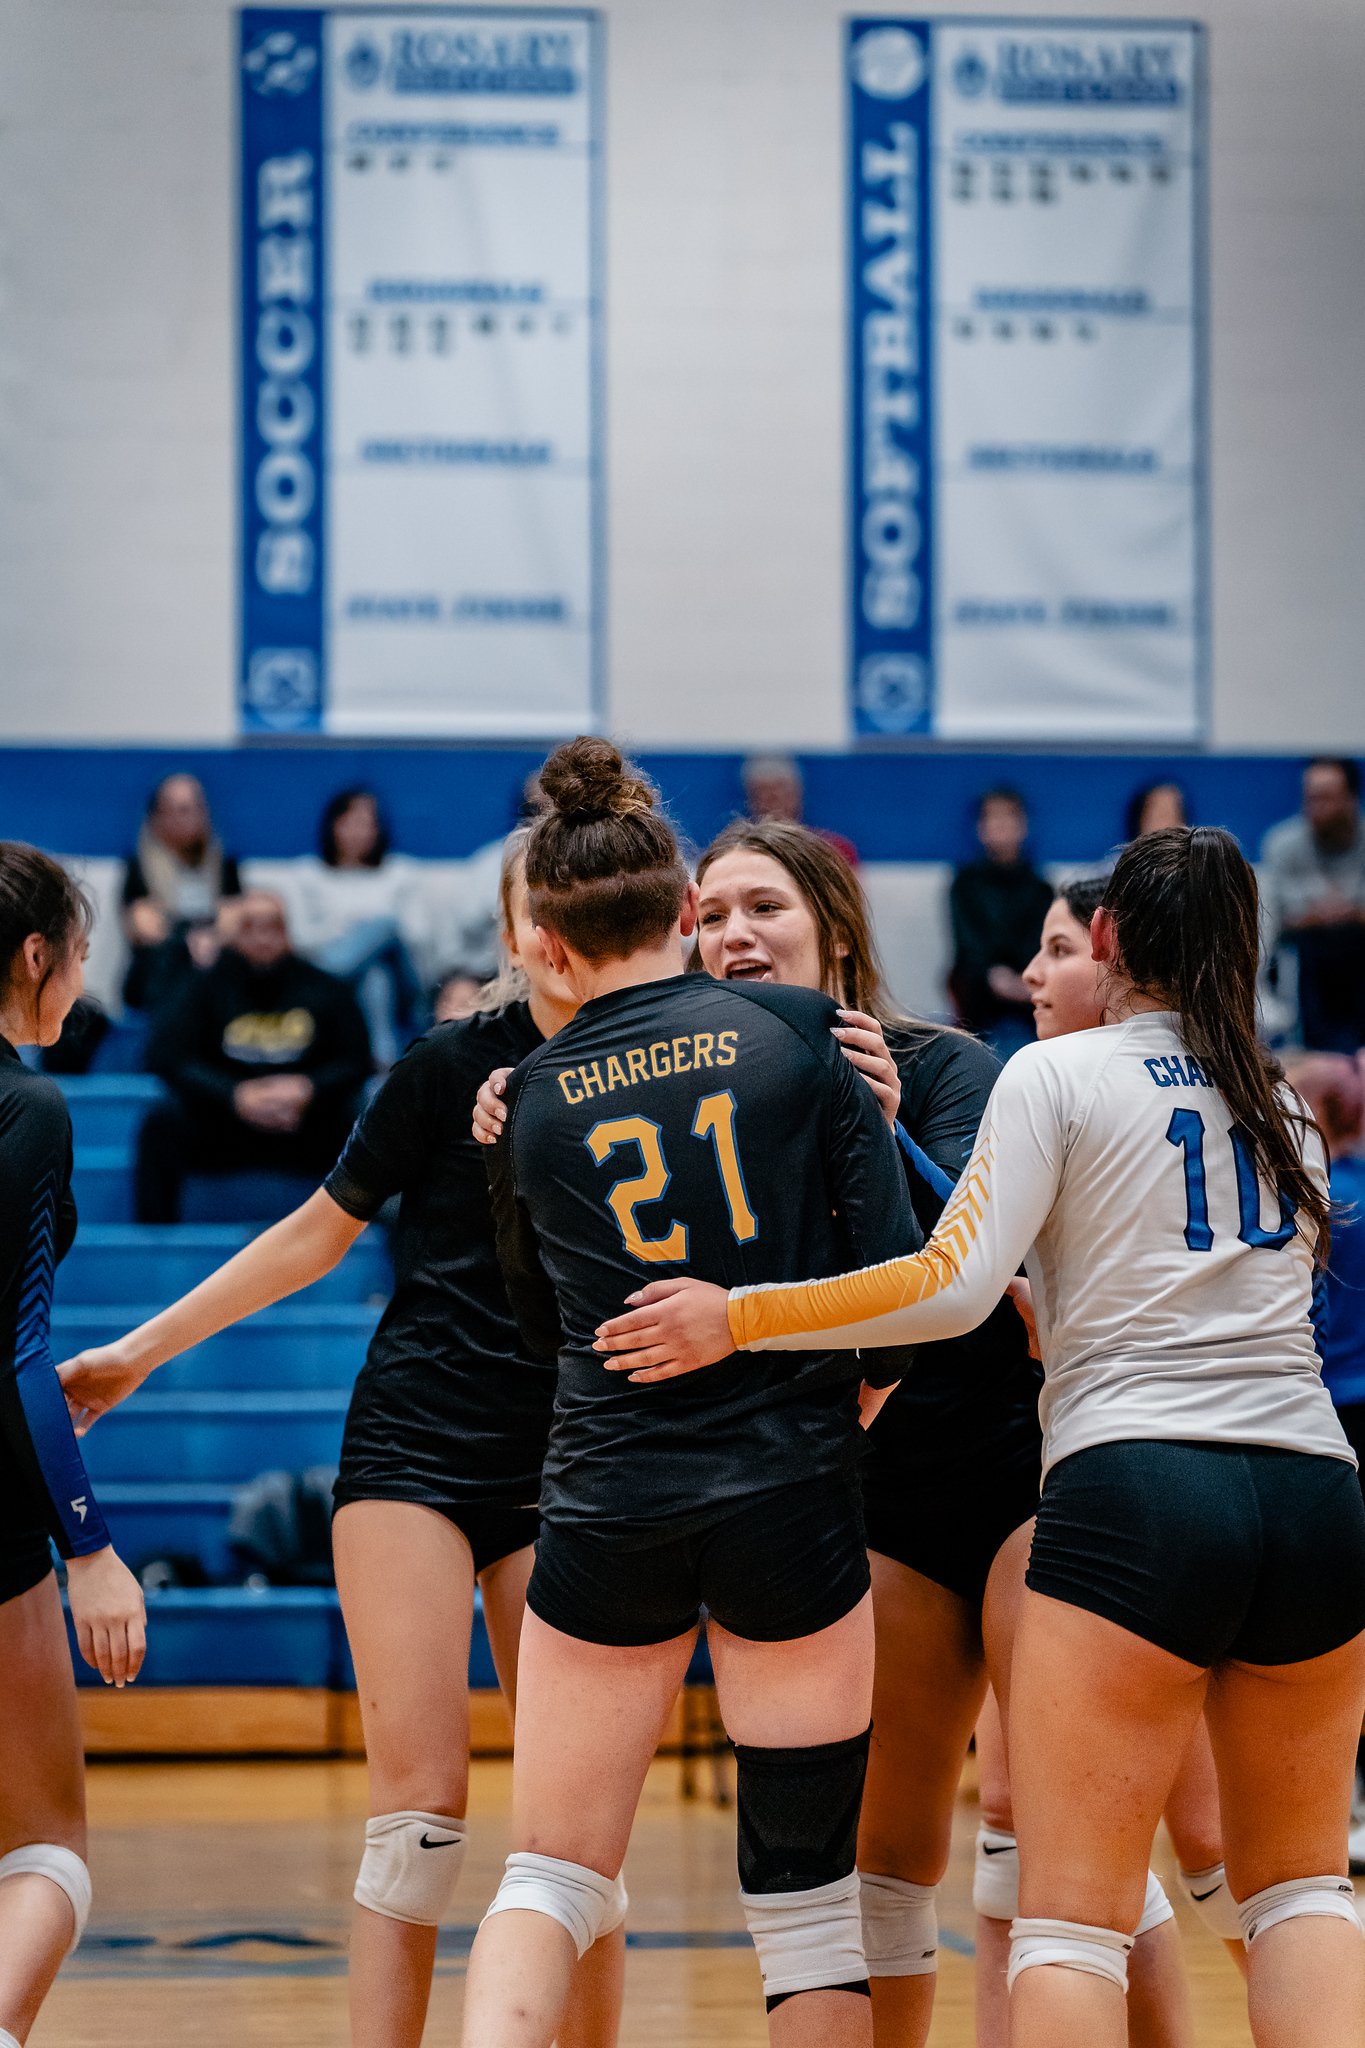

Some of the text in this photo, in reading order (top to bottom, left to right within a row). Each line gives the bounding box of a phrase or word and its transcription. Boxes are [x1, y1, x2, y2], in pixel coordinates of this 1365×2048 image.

[256, 150, 314, 594] SOCCER
[862, 122, 921, 629] SOFTBALL
[557, 1031, 738, 1105] CHARGERS
[583, 1088, 758, 1265] 21
